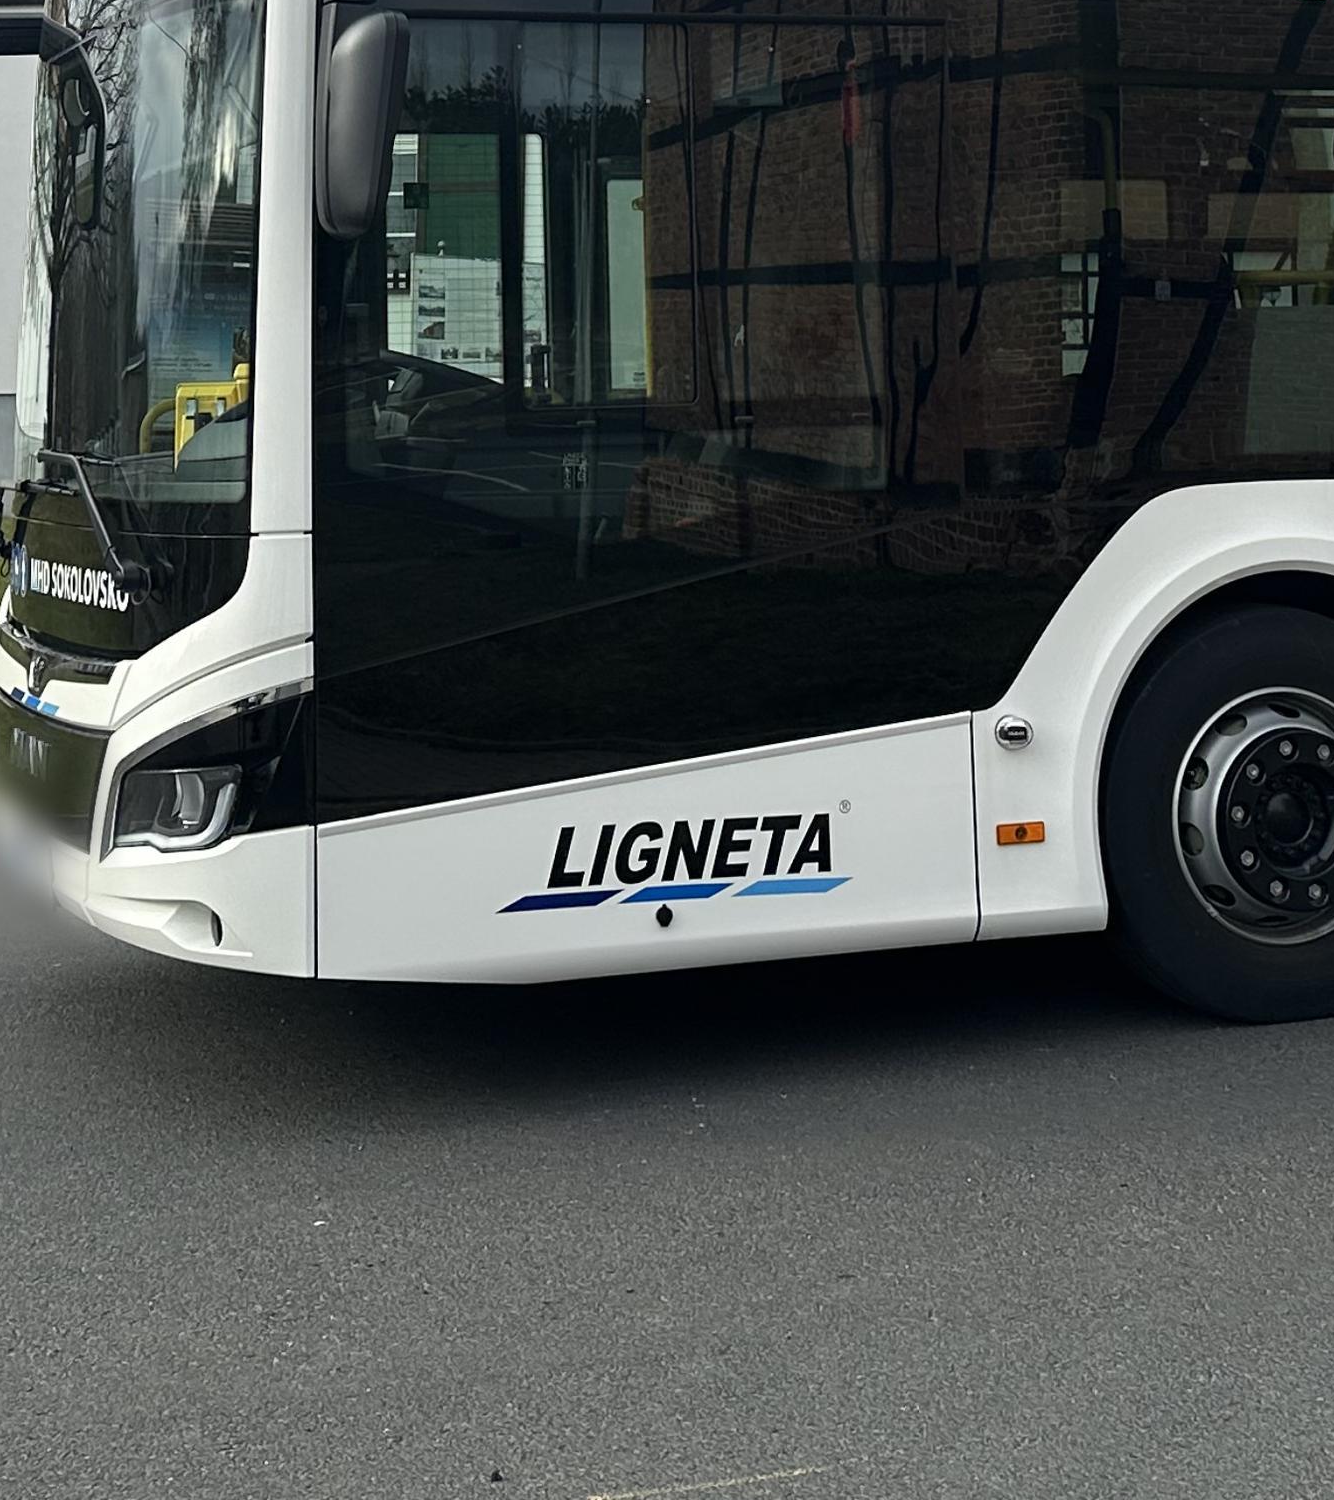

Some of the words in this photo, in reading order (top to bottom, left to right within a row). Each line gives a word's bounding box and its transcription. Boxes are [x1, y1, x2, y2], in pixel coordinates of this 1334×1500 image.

[30, 557, 50, 595] MHD
[51, 562, 129, 612] SOKOLOVSKO
[547, 812, 833, 889] LIGNETA
